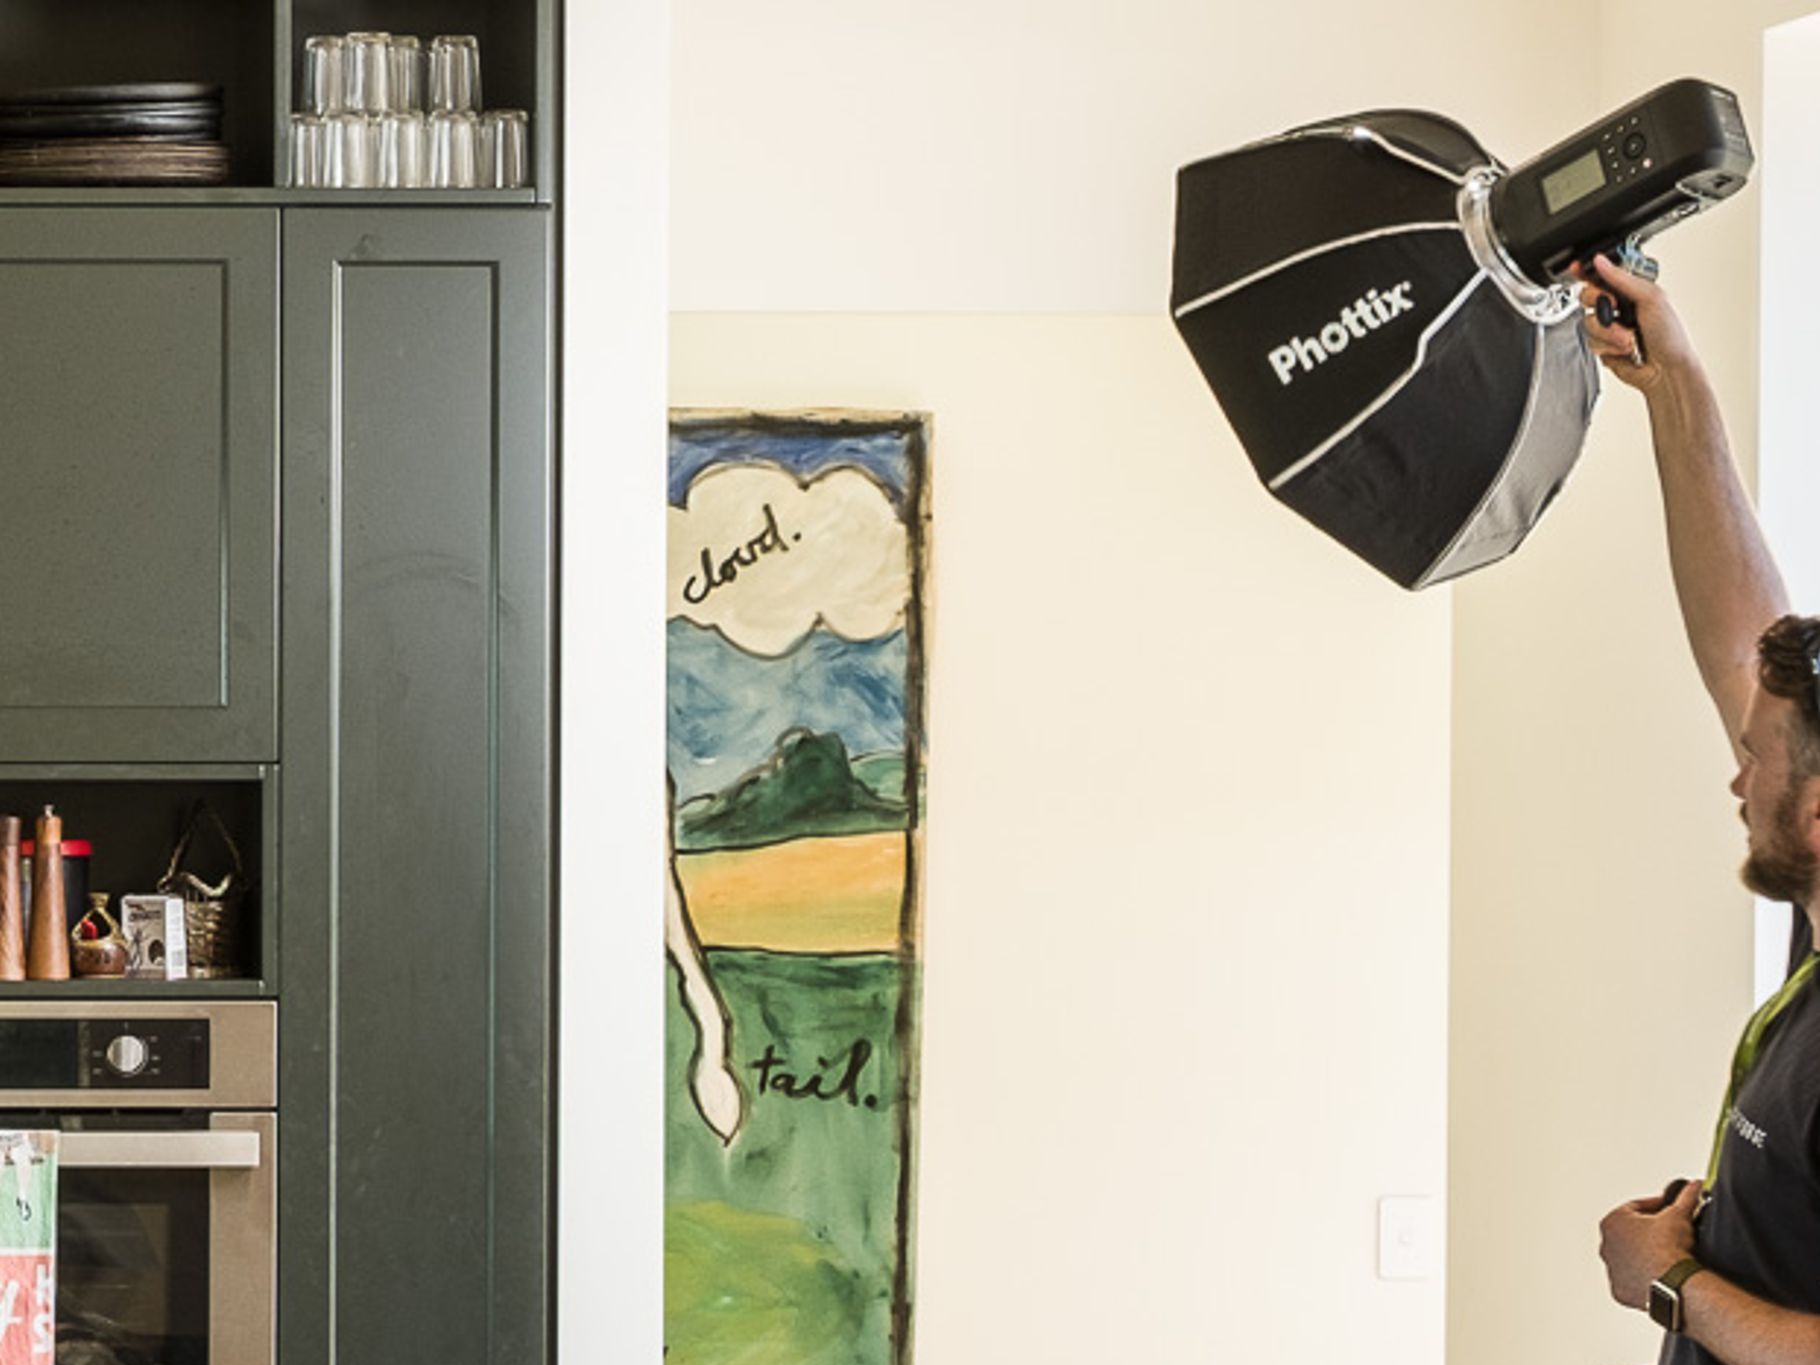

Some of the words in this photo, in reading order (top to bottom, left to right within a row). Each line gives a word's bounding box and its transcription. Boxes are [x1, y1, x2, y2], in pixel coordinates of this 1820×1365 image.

[1268, 281, 1415, 385] Phottix
[683, 503, 801, 604] cloud.
[748, 1039, 878, 1107] tail.
